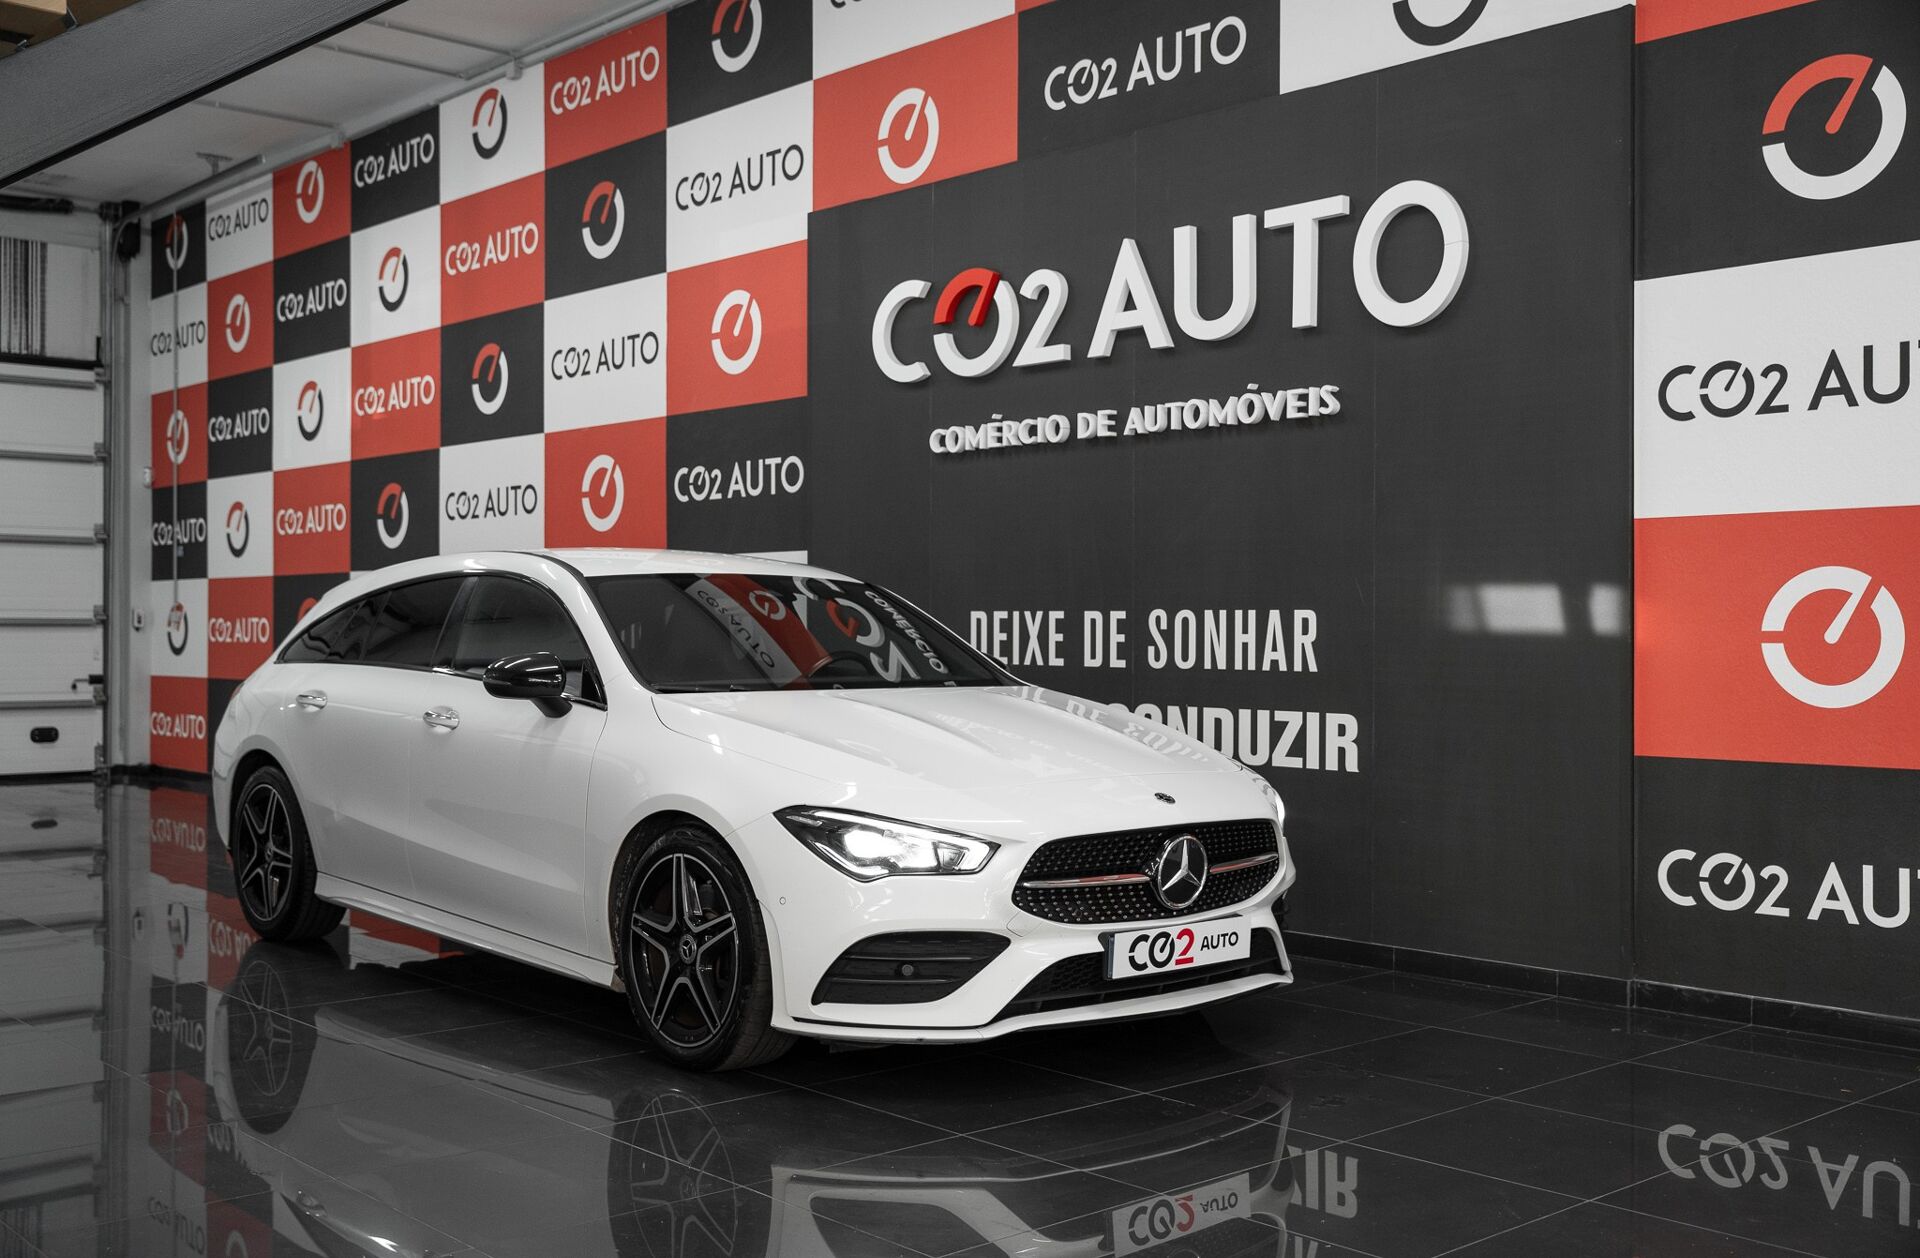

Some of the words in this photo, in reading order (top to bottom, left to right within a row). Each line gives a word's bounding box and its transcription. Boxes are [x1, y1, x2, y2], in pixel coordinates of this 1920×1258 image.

[551, 76, 591, 115] CO2
[596, 46, 659, 100] AUTO
[1045, 58, 1117, 110] CO2
[1127, 16, 1246, 91] AUTO
[355, 156, 385, 187] CO2
[387, 134, 435, 177] AUTO
[676, 172, 722, 210] CO2
[729, 144, 804, 198] AUTO
[208, 214, 231, 241] CO2
[233, 198, 269, 230] AUTO
[445, 242, 480, 275] CO2
[484, 223, 538, 266] AUTO
[277, 293, 304, 322] CO2
[306, 279, 347, 312] AUTO
[872, 268, 1072, 383] CO2
[1087, 180, 1469, 358] AUTO
[151, 331, 172, 356] CO2
[175, 321, 206, 348] AUTO
[552, 347, 590, 380] CO2
[596, 332, 659, 373] AUTO
[354, 386, 385, 416] CO2
[388, 375, 435, 411] AUTO
[1658, 361, 1789, 421] CO2
[1808, 340, 1920, 410] AU
[208, 416, 232, 442] CO2
[234, 408, 269, 438] AUTO
[929, 414, 1070, 453] COMÉRCIO
[1077, 410, 1117, 439] DE
[1124, 383, 1340, 435] AUTOMÓVEIS
[446, 491, 479, 520] CO2
[484, 484, 537, 518] AUTO
[674, 466, 722, 502] CO2
[728, 456, 804, 498] AUTO
[152, 522, 173, 546] CO2
[175, 517, 206, 544] AUTO
[277, 508, 303, 535] CO2
[305, 503, 346, 533] AUTO
[210, 617, 232, 643] CO2
[234, 617, 269, 643] AUTO
[970, 609, 1065, 667] DEIXE
[1084, 611, 1126, 668] DE
[1148, 609, 1317, 672] SONHAR
[151, 713, 172, 736] CO2
[173, 714, 206, 739] AUTO
[1107, 703, 1359, 773] DUZIR
[1658, 849, 1789, 917] CO2
[1807, 862, 1920, 928] AU
[1129, 928, 1194, 971] CO2
[1201, 931, 1240, 951] AUTO
